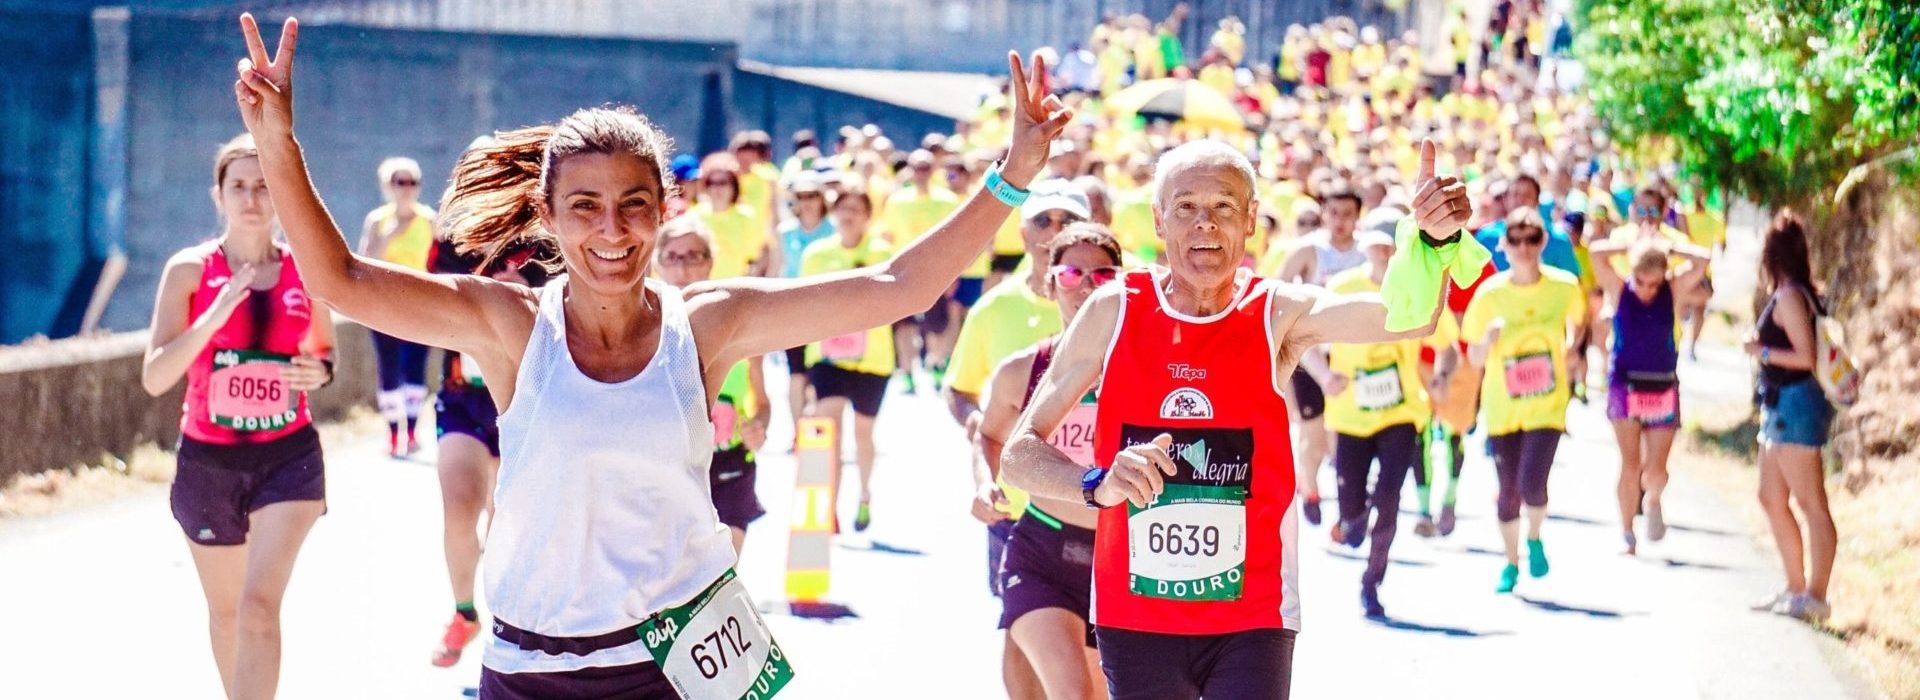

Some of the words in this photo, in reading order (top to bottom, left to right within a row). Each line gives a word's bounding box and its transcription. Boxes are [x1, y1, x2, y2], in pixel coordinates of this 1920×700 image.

[229, 376, 281, 402] 6056
[232, 409, 297, 430] DOURO
[1054, 423, 1095, 448] 124
[1192, 448, 1248, 486] alegria
[1149, 522, 1219, 557] 6639
[1157, 568, 1241, 597] DOURO
[690, 615, 752, 680] 6712
